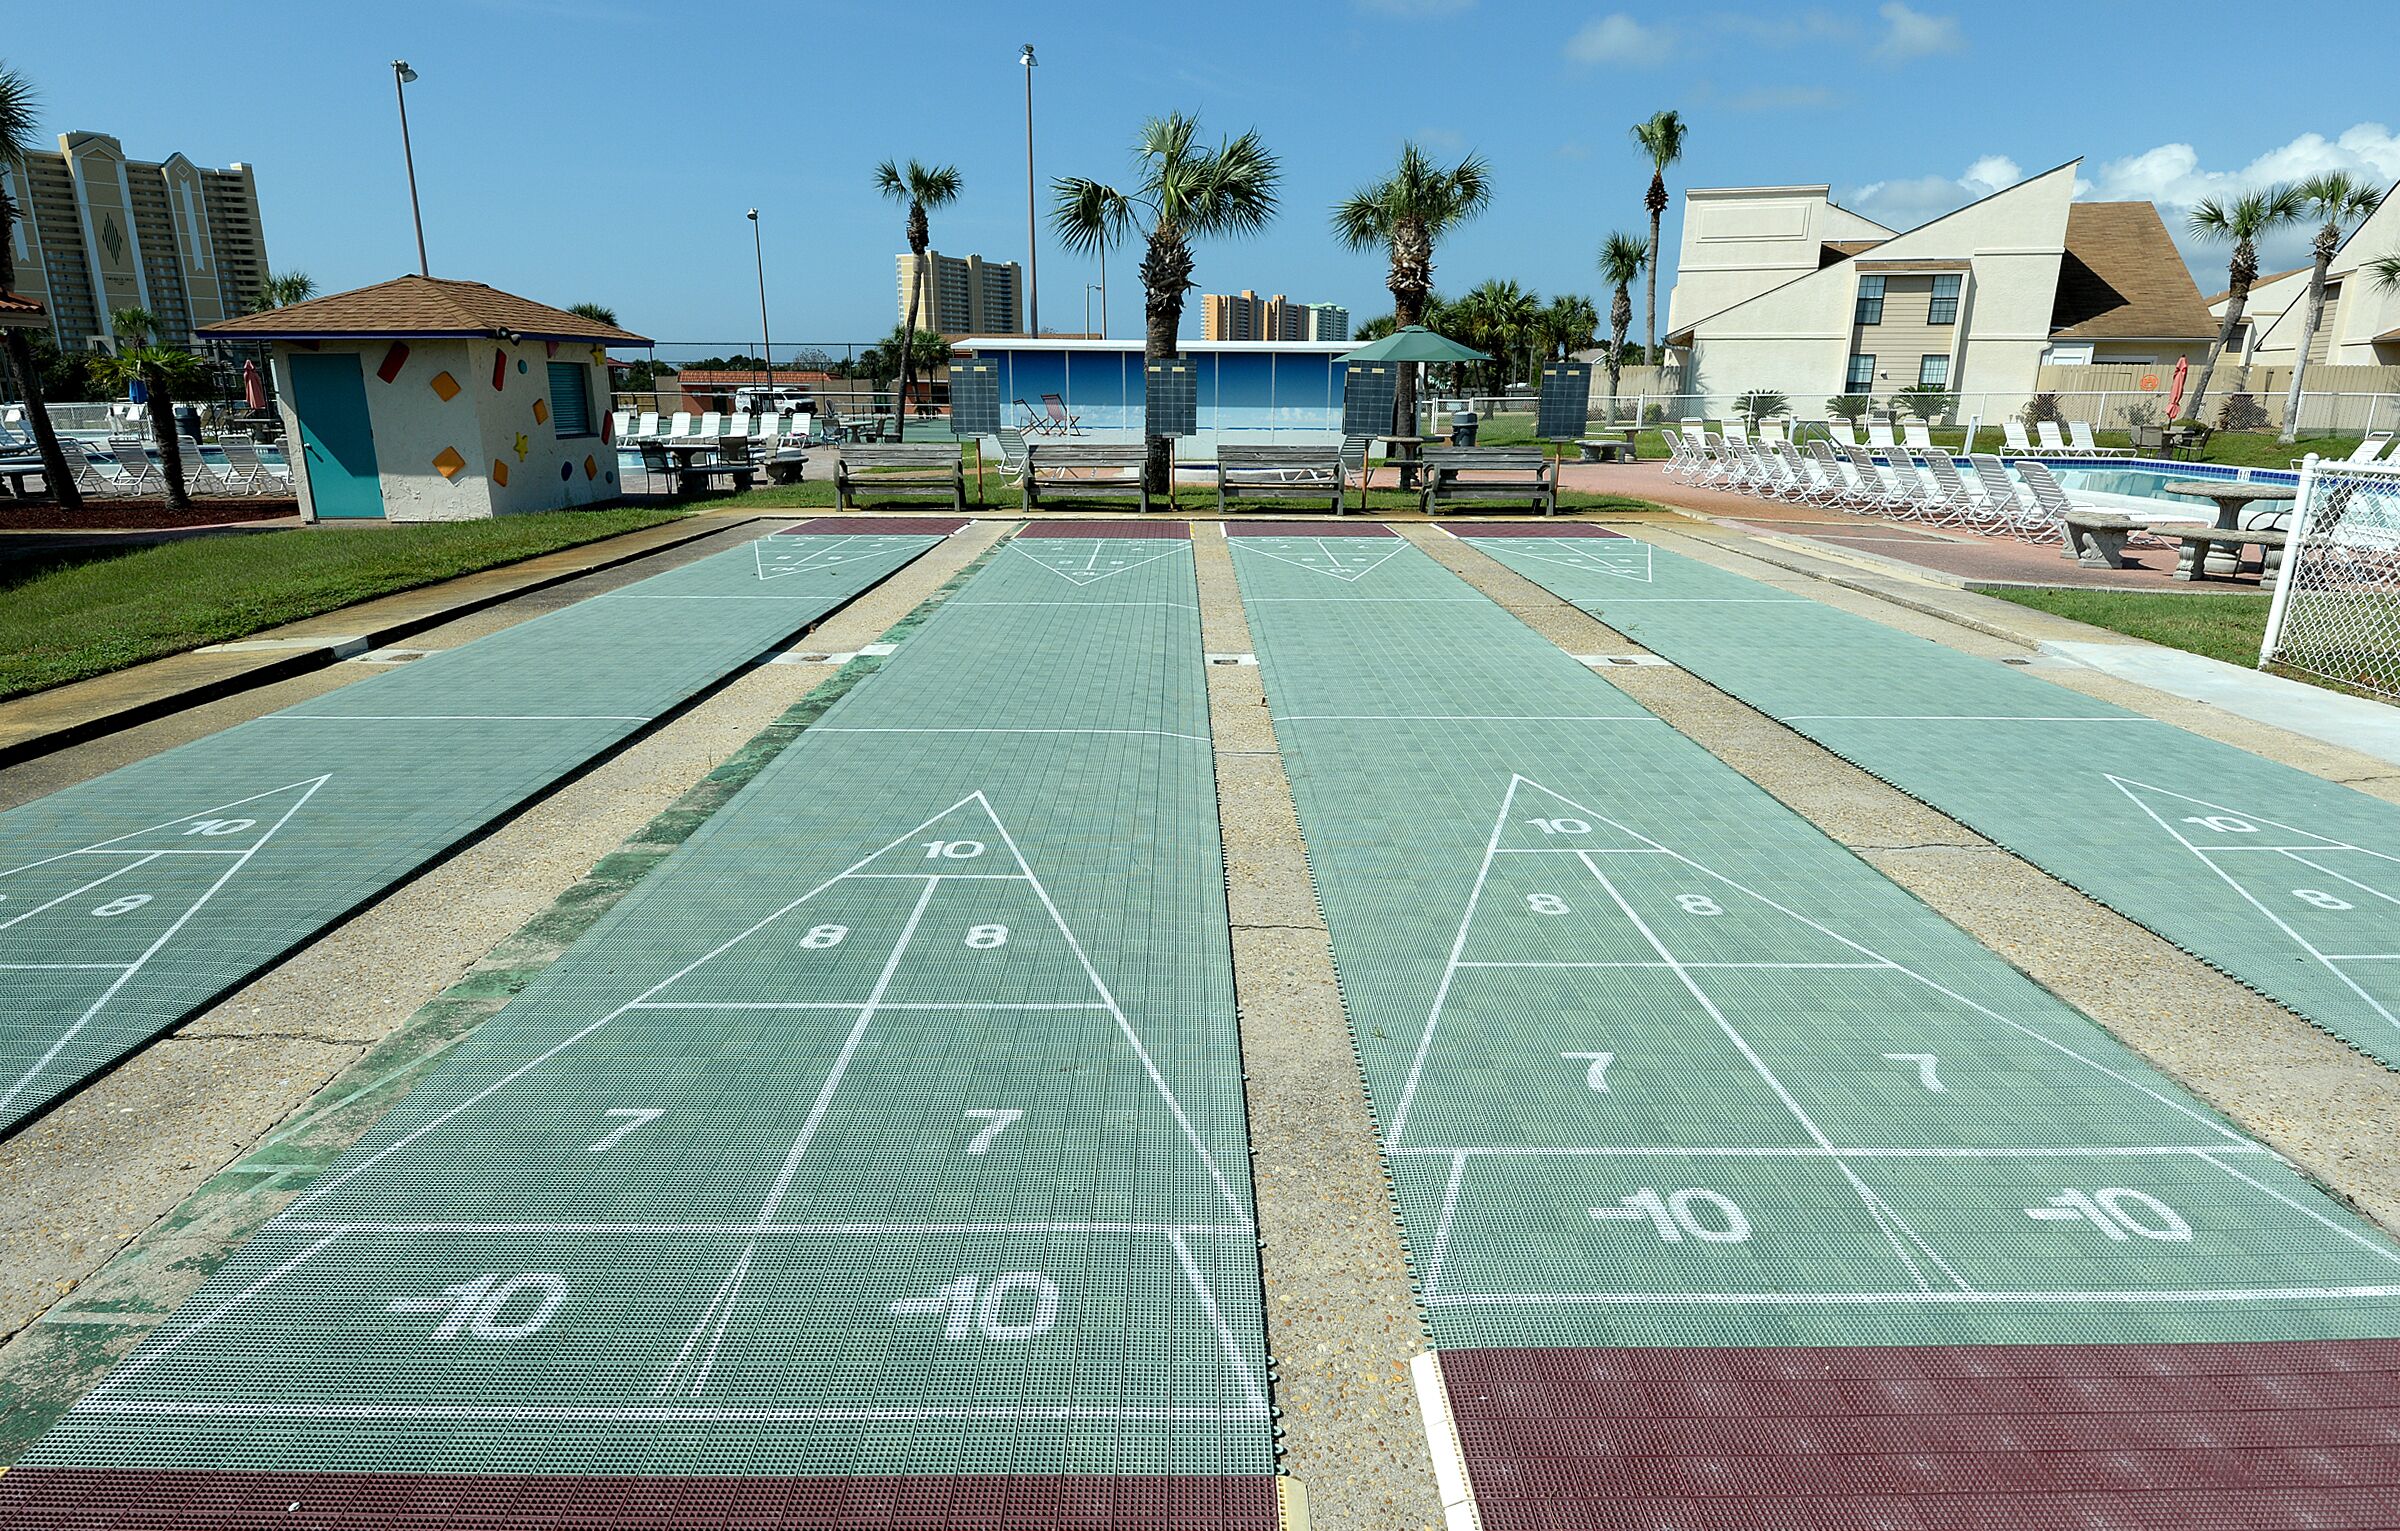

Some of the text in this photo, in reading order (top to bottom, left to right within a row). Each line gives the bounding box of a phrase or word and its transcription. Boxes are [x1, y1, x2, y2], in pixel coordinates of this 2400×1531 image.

[181, 818, 256, 836] 10
[1525, 818, 1592, 835] 10
[2180, 816, 2260, 833] 10
[920, 840, 985, 859] 10
[1527, 893, 1571, 915] 8
[1675, 894, 1724, 916] 8
[2291, 889, 2355, 910] 8
[800, 924, 849, 950] 8
[964, 924, 1009, 949] 8
[1561, 1050, 1615, 1093] 7
[1882, 1052, 1947, 1093] 7
[589, 1108, 665, 1153] 7
[962, 1108, 1024, 1155] 7
[1588, 1187, 1752, 1243] -10
[2024, 1186, 2195, 1243] -10
[386, 1272, 570, 1341] -10
[888, 1271, 1059, 1342] -10
